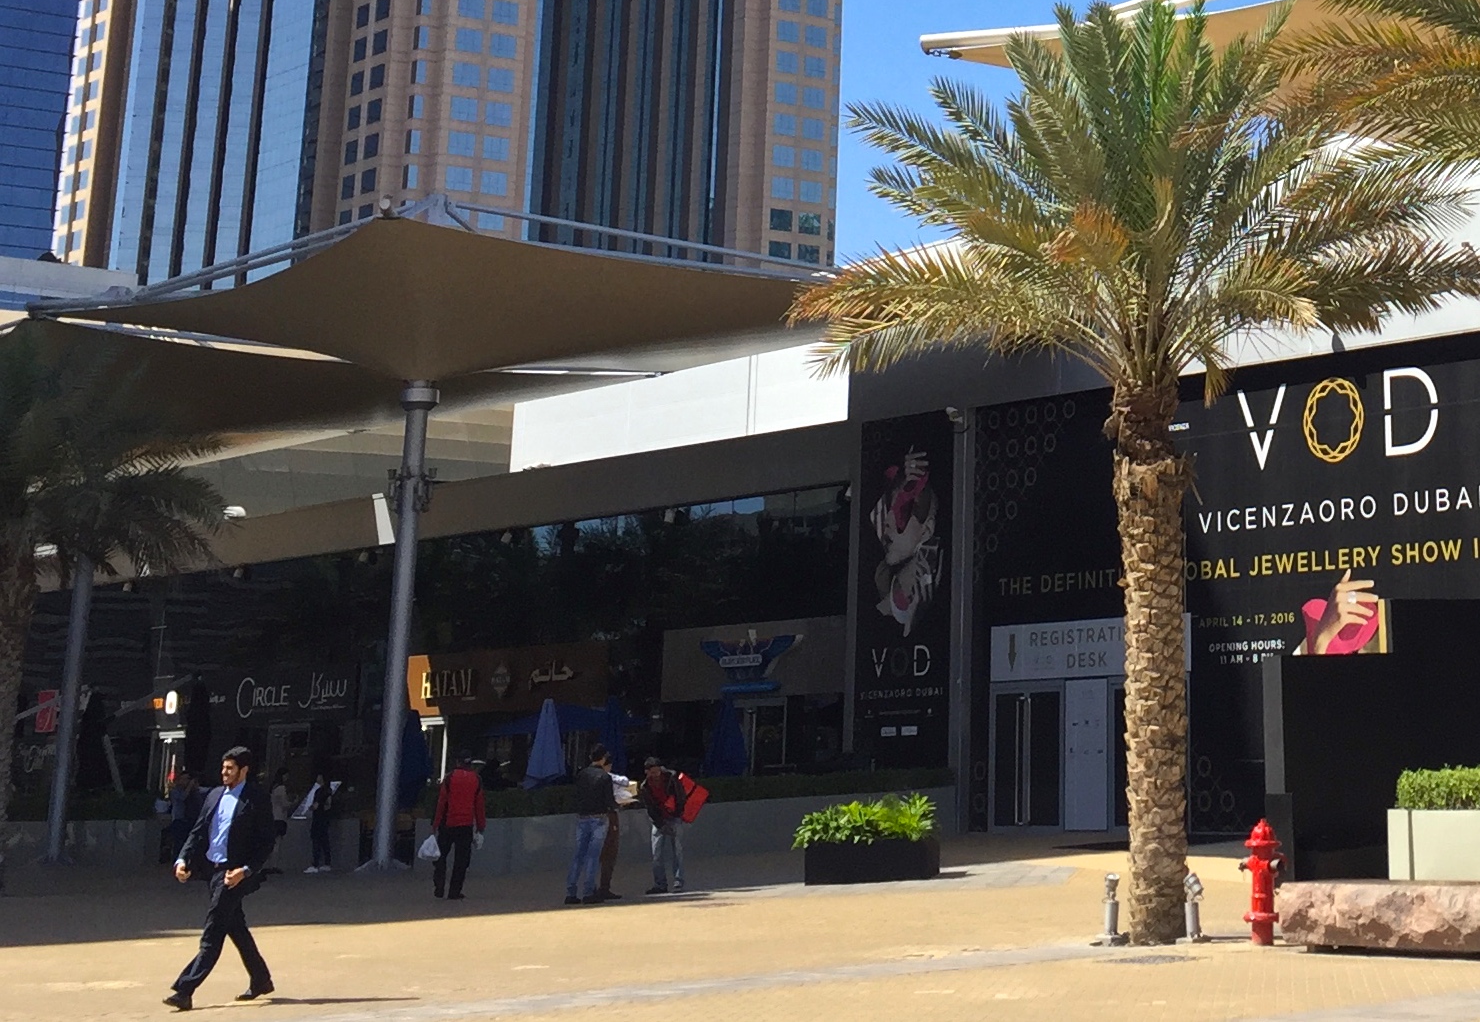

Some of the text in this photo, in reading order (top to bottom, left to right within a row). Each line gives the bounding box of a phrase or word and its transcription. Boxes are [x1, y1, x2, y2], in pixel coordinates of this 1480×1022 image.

[1237, 366, 1439, 471] VOD
[1198, 494, 1377, 534] VICENZAORO
[998, 576, 1032, 596] THE
[1040, 567, 1122, 594] DEFINITI
[1186, 557, 1241, 581] OBAL
[1249, 545, 1381, 577] JEWELLERY
[1391, 538, 1462, 566] SHOW
[1199, 616, 1229, 629] APRIL
[1231, 615, 1243, 626] 14
[1253, 613, 1268, 627] 17,
[1270, 611, 1296, 625] 2016
[1028, 625, 1124, 647] REGISTRATI
[1208, 638, 1286, 653] OPENING HOURS:
[1066, 651, 1108, 669] DESK
[1230, 653, 1244, 664] AM
[1252, 653, 1259, 664] 8
[420, 668, 473, 699] HATAM
